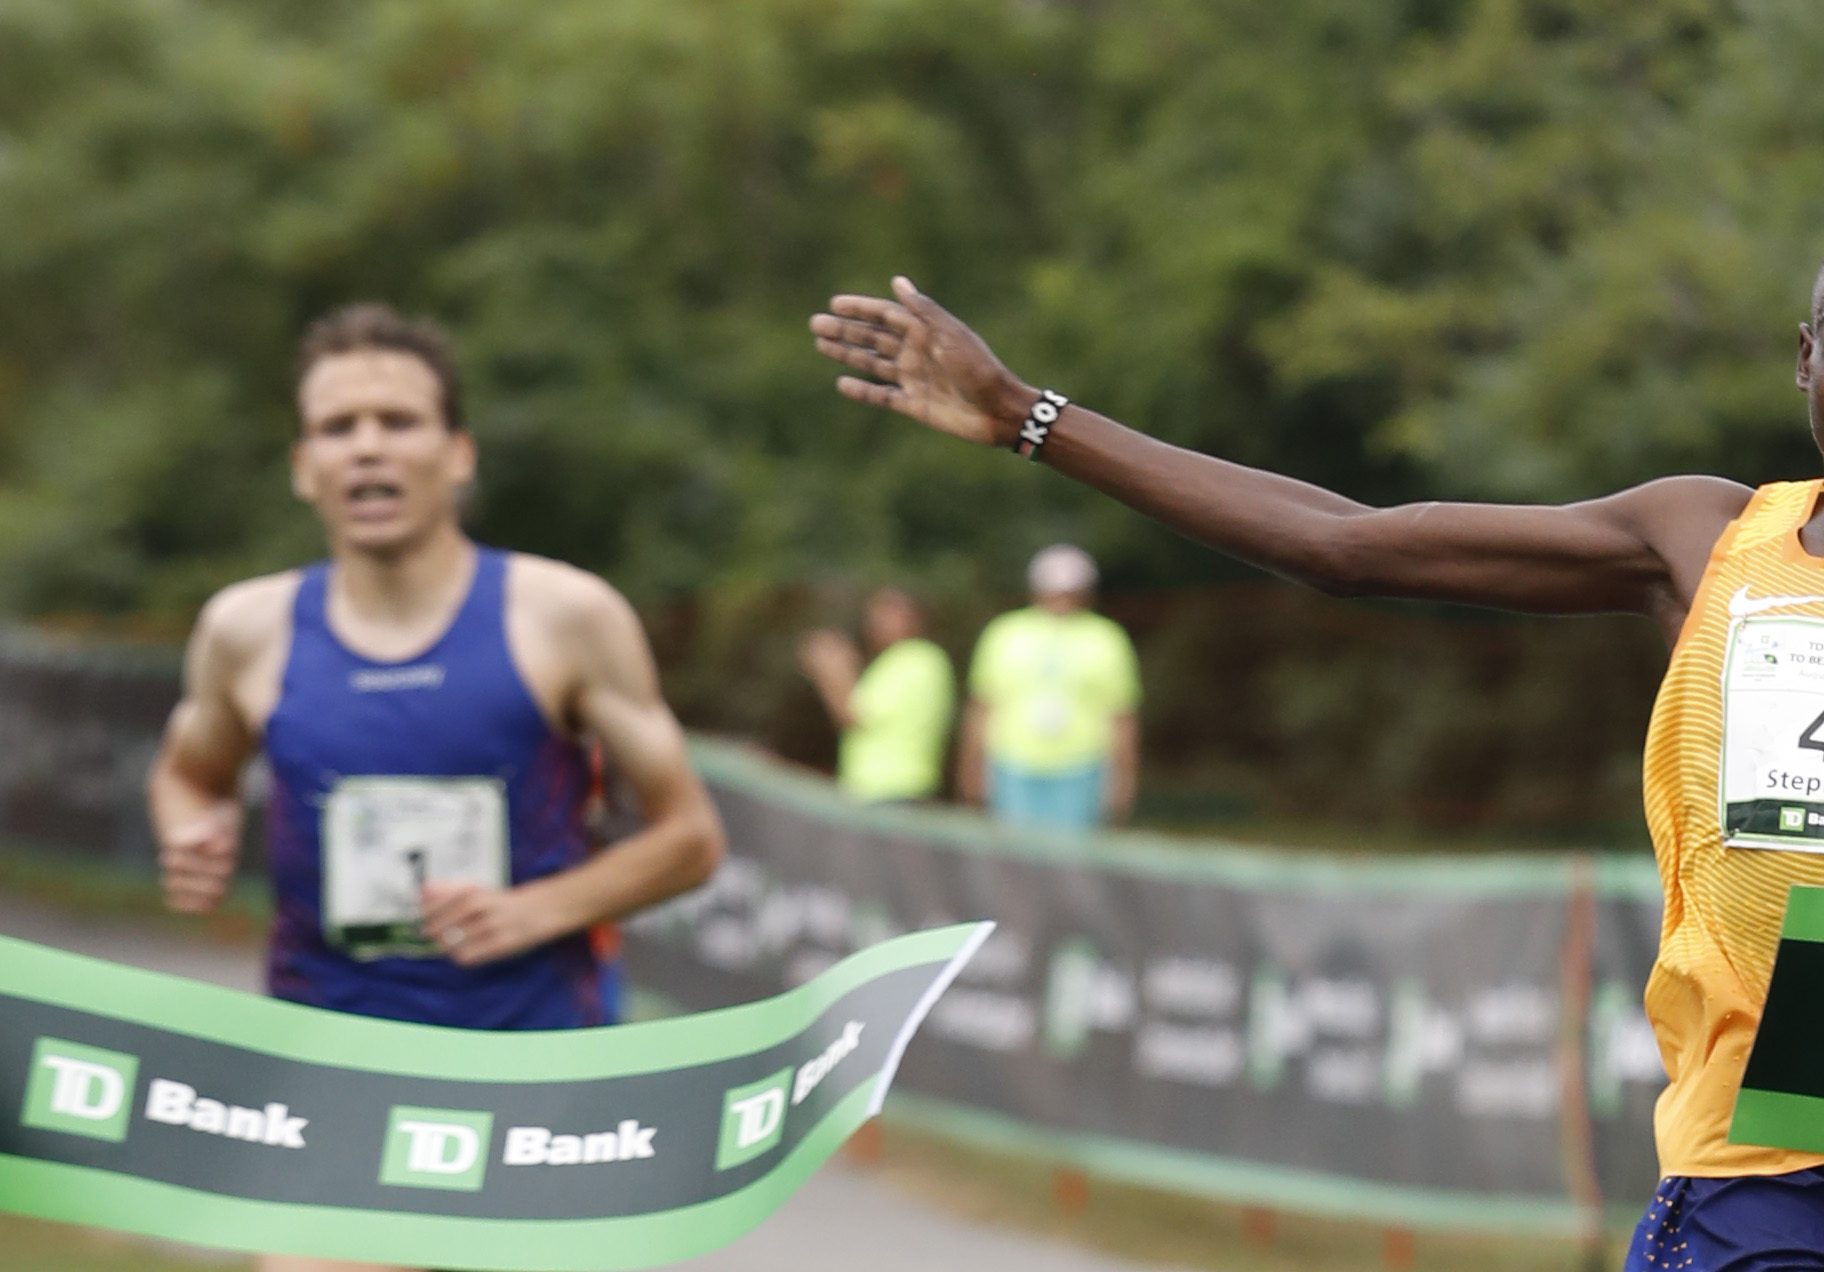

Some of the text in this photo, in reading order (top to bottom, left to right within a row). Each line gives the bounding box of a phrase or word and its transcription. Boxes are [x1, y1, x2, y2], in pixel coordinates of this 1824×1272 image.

[1790, 652, 1806, 664] TO
[1808, 640, 1824, 652] TD
[43, 1054, 310, 1151] TD Bank
[732, 1086, 785, 1150] TD
[398, 1119, 658, 1174] TD Bank
